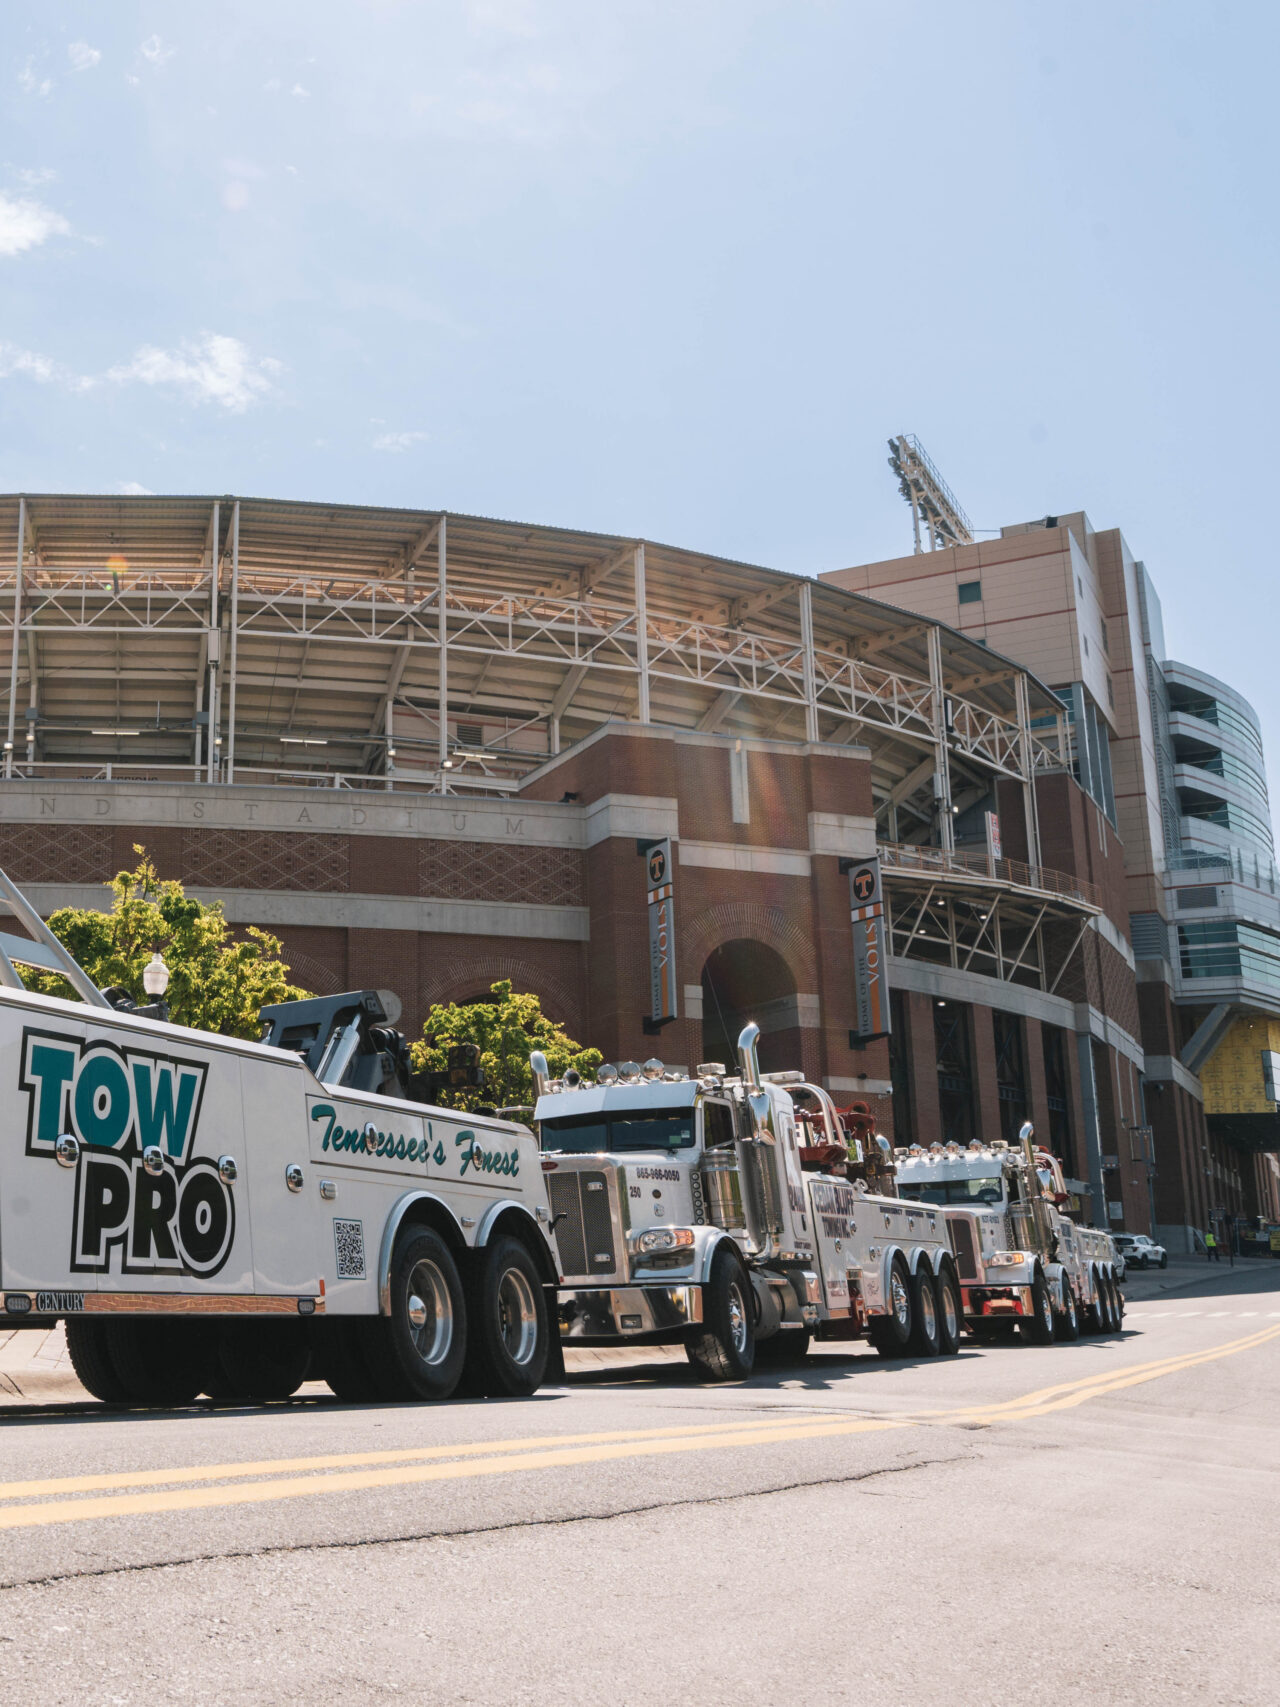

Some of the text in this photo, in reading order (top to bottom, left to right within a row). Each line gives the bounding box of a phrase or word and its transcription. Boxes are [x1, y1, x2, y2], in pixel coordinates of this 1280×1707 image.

[193, 802, 524, 835] STADIUM
[656, 904, 669, 969] VOLS
[865, 922, 880, 985] VOLS
[23, 1032, 205, 1165] TOW
[455, 1130, 519, 1177] Fnest
[73, 1153, 234, 1275] PRO
[630, 1186, 641, 1198] 250
[38, 1292, 85, 1311] CENTURY
